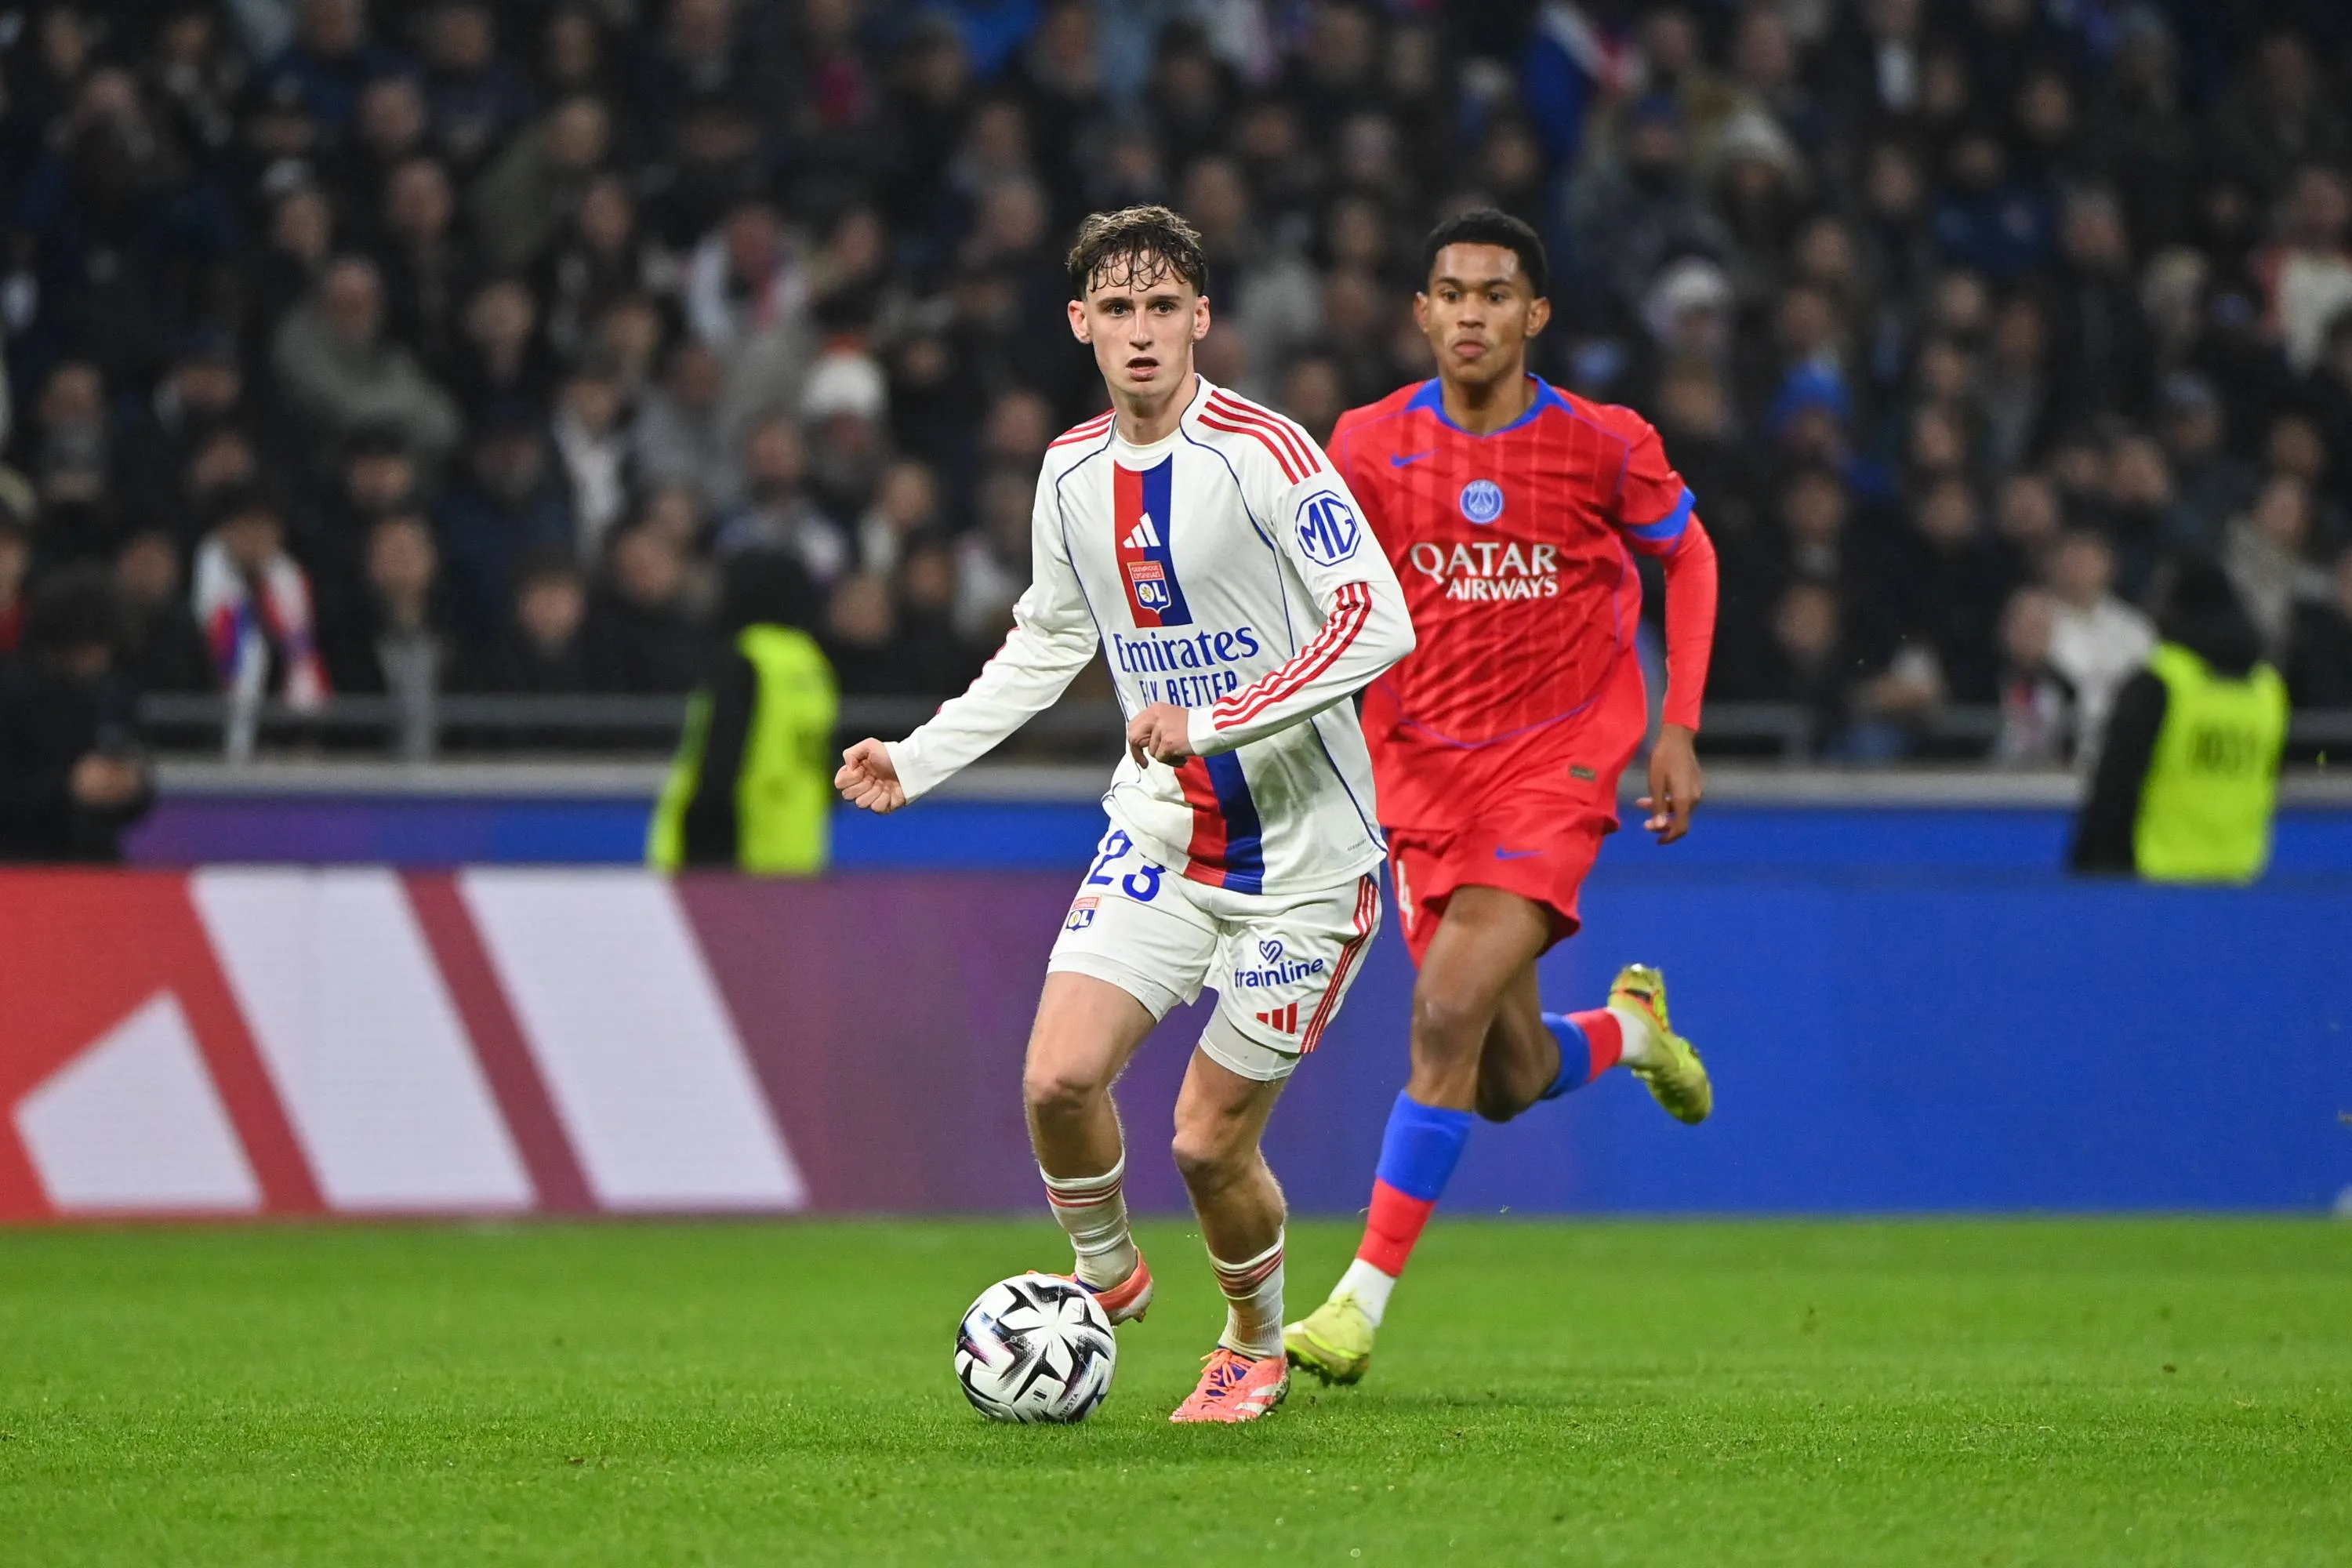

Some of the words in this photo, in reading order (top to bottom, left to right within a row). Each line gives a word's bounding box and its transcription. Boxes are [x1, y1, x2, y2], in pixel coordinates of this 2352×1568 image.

[1300, 497, 1356, 559] MG
[1410, 542, 1558, 584] QATAR
[1138, 582, 1167, 603] OL
[1446, 575, 1559, 601] AIRWAYS
[1112, 627, 1259, 673] Emirates
[1165, 670, 1238, 708] BETTER
[1087, 829, 1167, 902] 23
[1234, 958, 1324, 988] trainline
